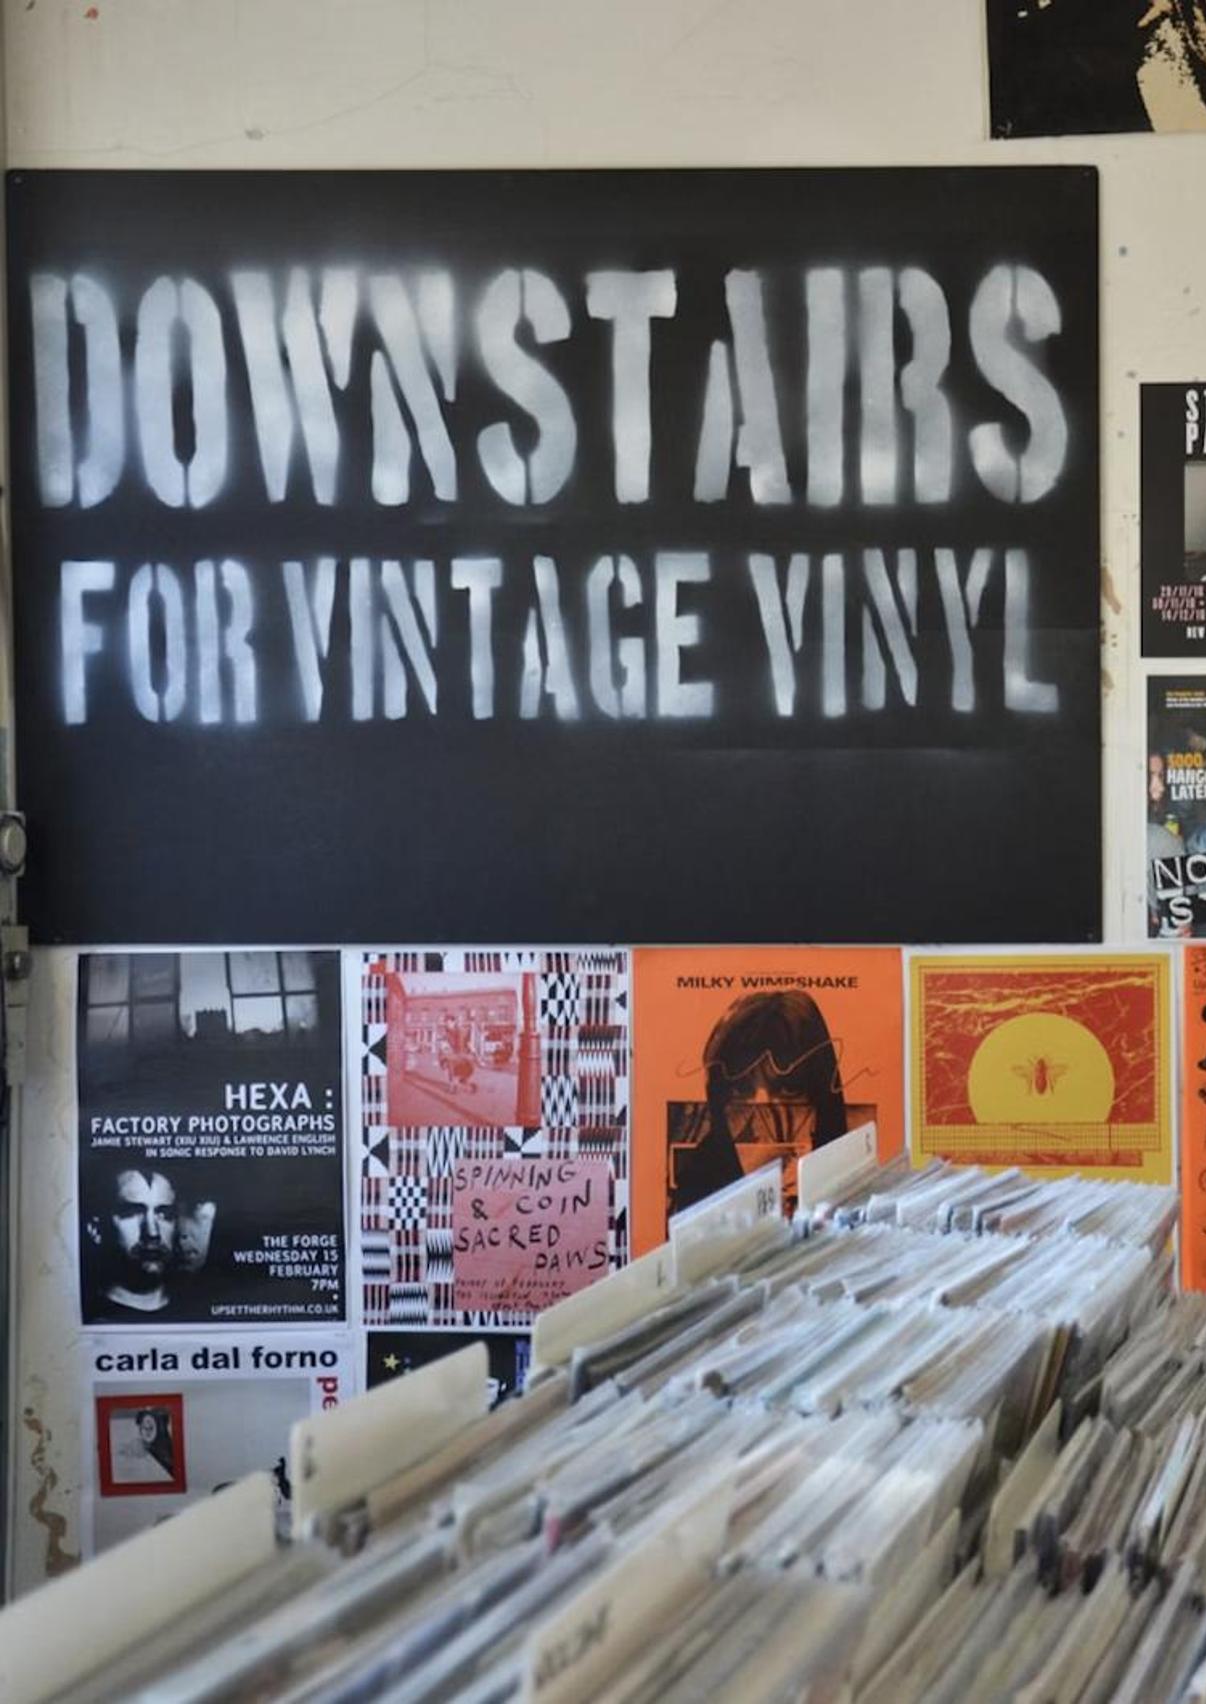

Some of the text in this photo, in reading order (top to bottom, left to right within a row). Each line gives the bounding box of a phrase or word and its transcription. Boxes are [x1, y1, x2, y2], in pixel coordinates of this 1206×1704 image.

[28, 263, 1069, 511] DOWNSTAIRS
[60, 547, 1060, 726] FOR VINTAGE VINYL
[677, 976, 860, 989] MILKY WIMPSHAKE
[225, 1083, 312, 1110] HEXA
[91, 1114, 335, 1134] FACTORY PHOTOGRAPHS
[91, 1137, 121, 1147] JAMIE
[125, 1136, 171, 1147] STEWART
[234, 1134, 288, 1145] LAWRENCE
[292, 1134, 336, 1145] ENGLISH
[146, 1146, 336, 1158] IN SONIC RESPONSE TO DAVID LYNCH
[454, 1161, 576, 1191] SPINNING
[471, 1179, 591, 1220] & COIN
[263, 1235, 337, 1248] THE FORGE
[454, 1224, 560, 1253] SACRED
[234, 1250, 338, 1262] WEDNESDAY 15
[535, 1241, 607, 1273] PAWS
[270, 1264, 338, 1277] FEBRUARY
[311, 1279, 338, 1291] 7PM
[211, 1304, 339, 1315] UPSETTHERHYTHM.CO.UK
[95, 1346, 338, 1372] carla dal forno
